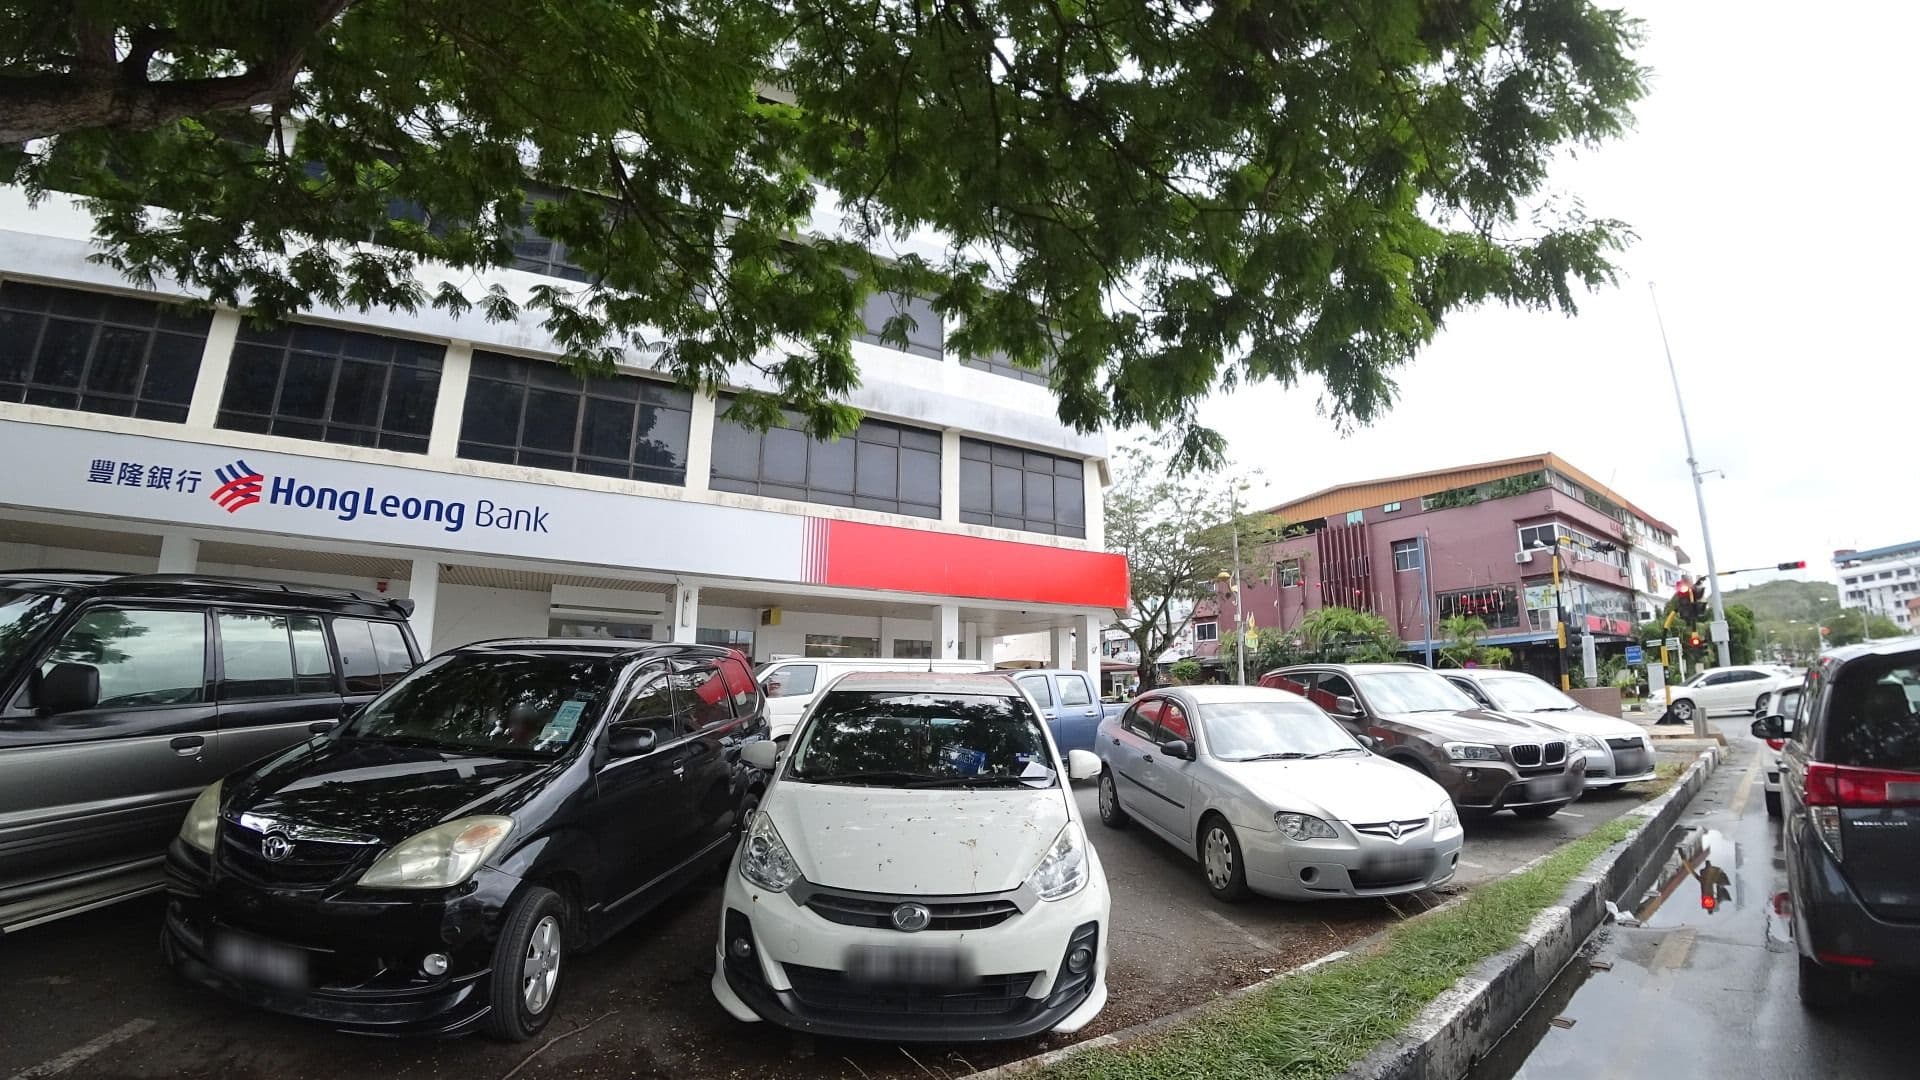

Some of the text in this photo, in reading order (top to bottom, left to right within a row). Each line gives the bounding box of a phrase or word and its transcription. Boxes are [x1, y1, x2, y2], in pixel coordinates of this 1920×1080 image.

[87, 458, 202, 494] 豐隆銀行
[475, 499, 550, 533] Bank
